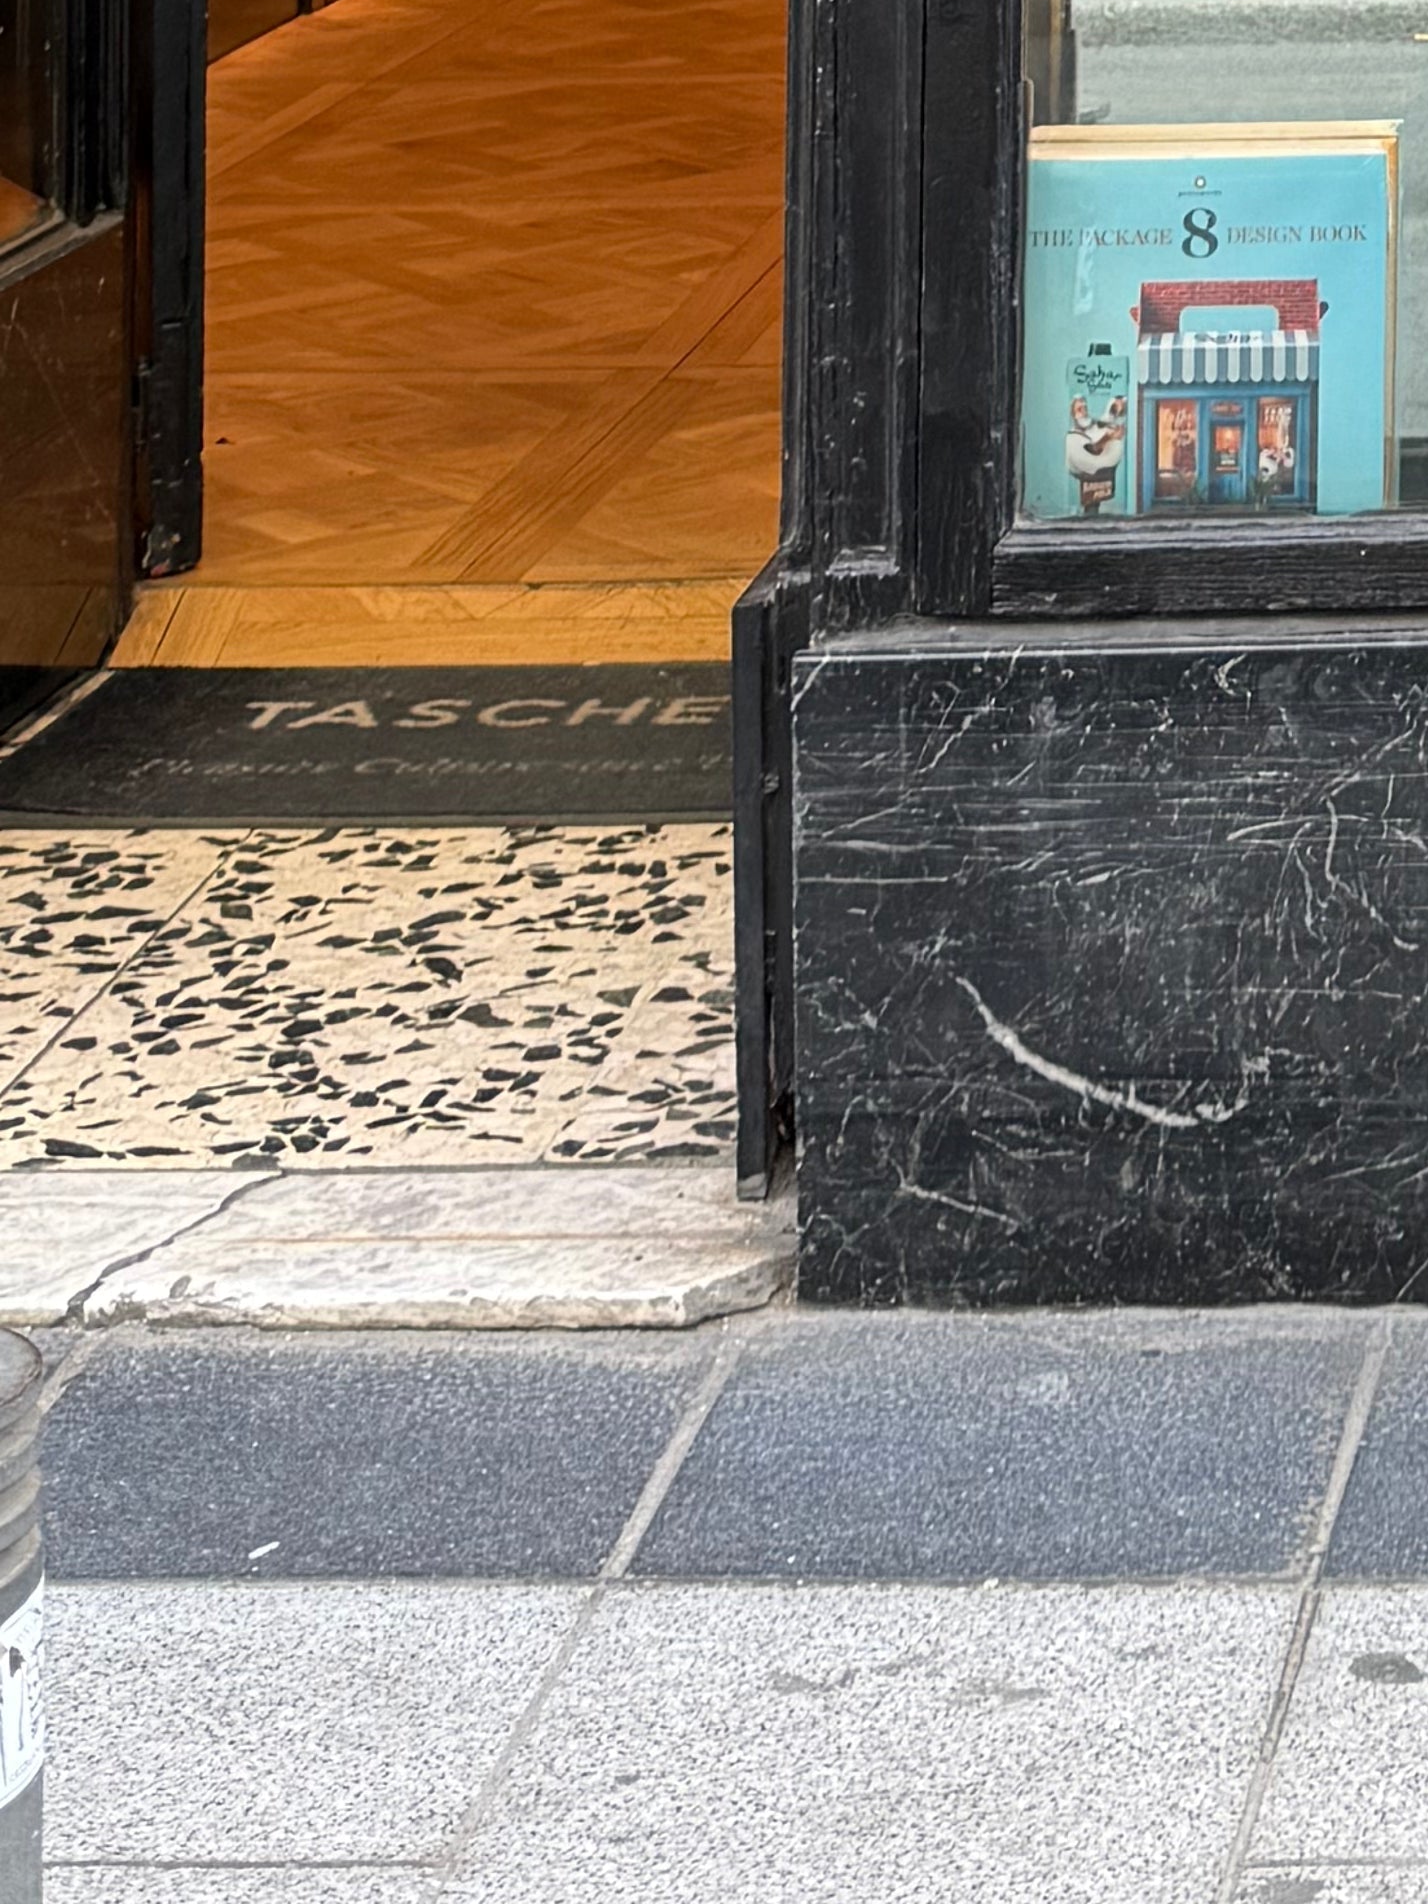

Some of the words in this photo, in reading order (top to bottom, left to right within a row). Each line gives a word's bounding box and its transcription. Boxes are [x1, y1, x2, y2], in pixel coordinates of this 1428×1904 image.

[1029, 229, 1073, 248] THE
[1078, 227, 1173, 247] PACKAGE
[1226, 225, 1303, 245] DESIGN
[1309, 224, 1368, 243] BOOK
[1181, 207, 1219, 259] 8
